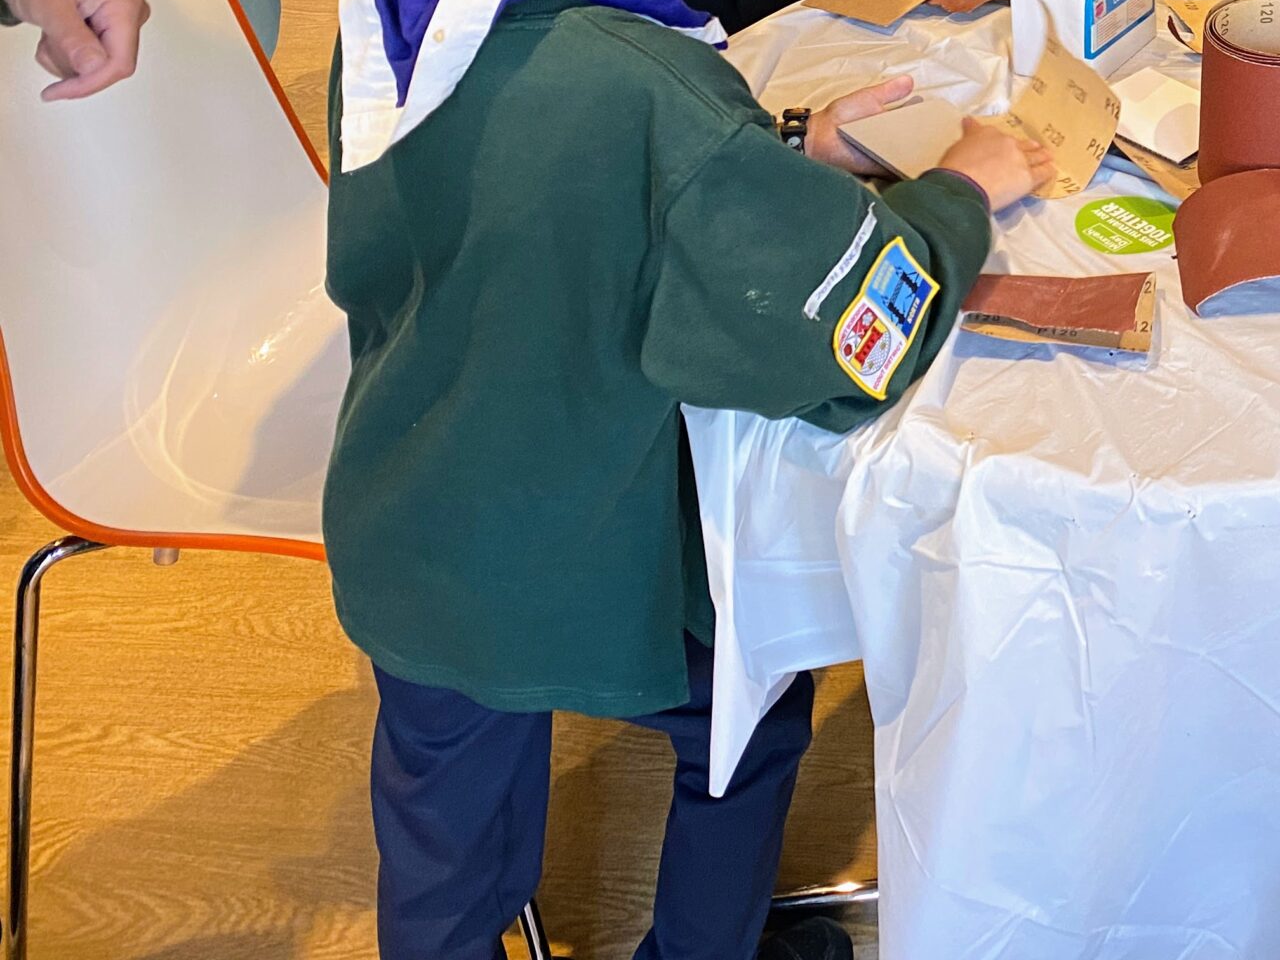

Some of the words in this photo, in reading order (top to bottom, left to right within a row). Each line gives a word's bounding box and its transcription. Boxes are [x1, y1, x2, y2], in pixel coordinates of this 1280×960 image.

[1219, 7, 1230, 36] 120
[1104, 98, 1121, 121] P12
[1086, 138, 1105, 161] P12
[1057, 177, 1081, 195] P12
[1100, 202, 1172, 243] TOGETHER
[1086, 227, 1119, 251] Mitzvah
[1109, 234, 1128, 247] Day
